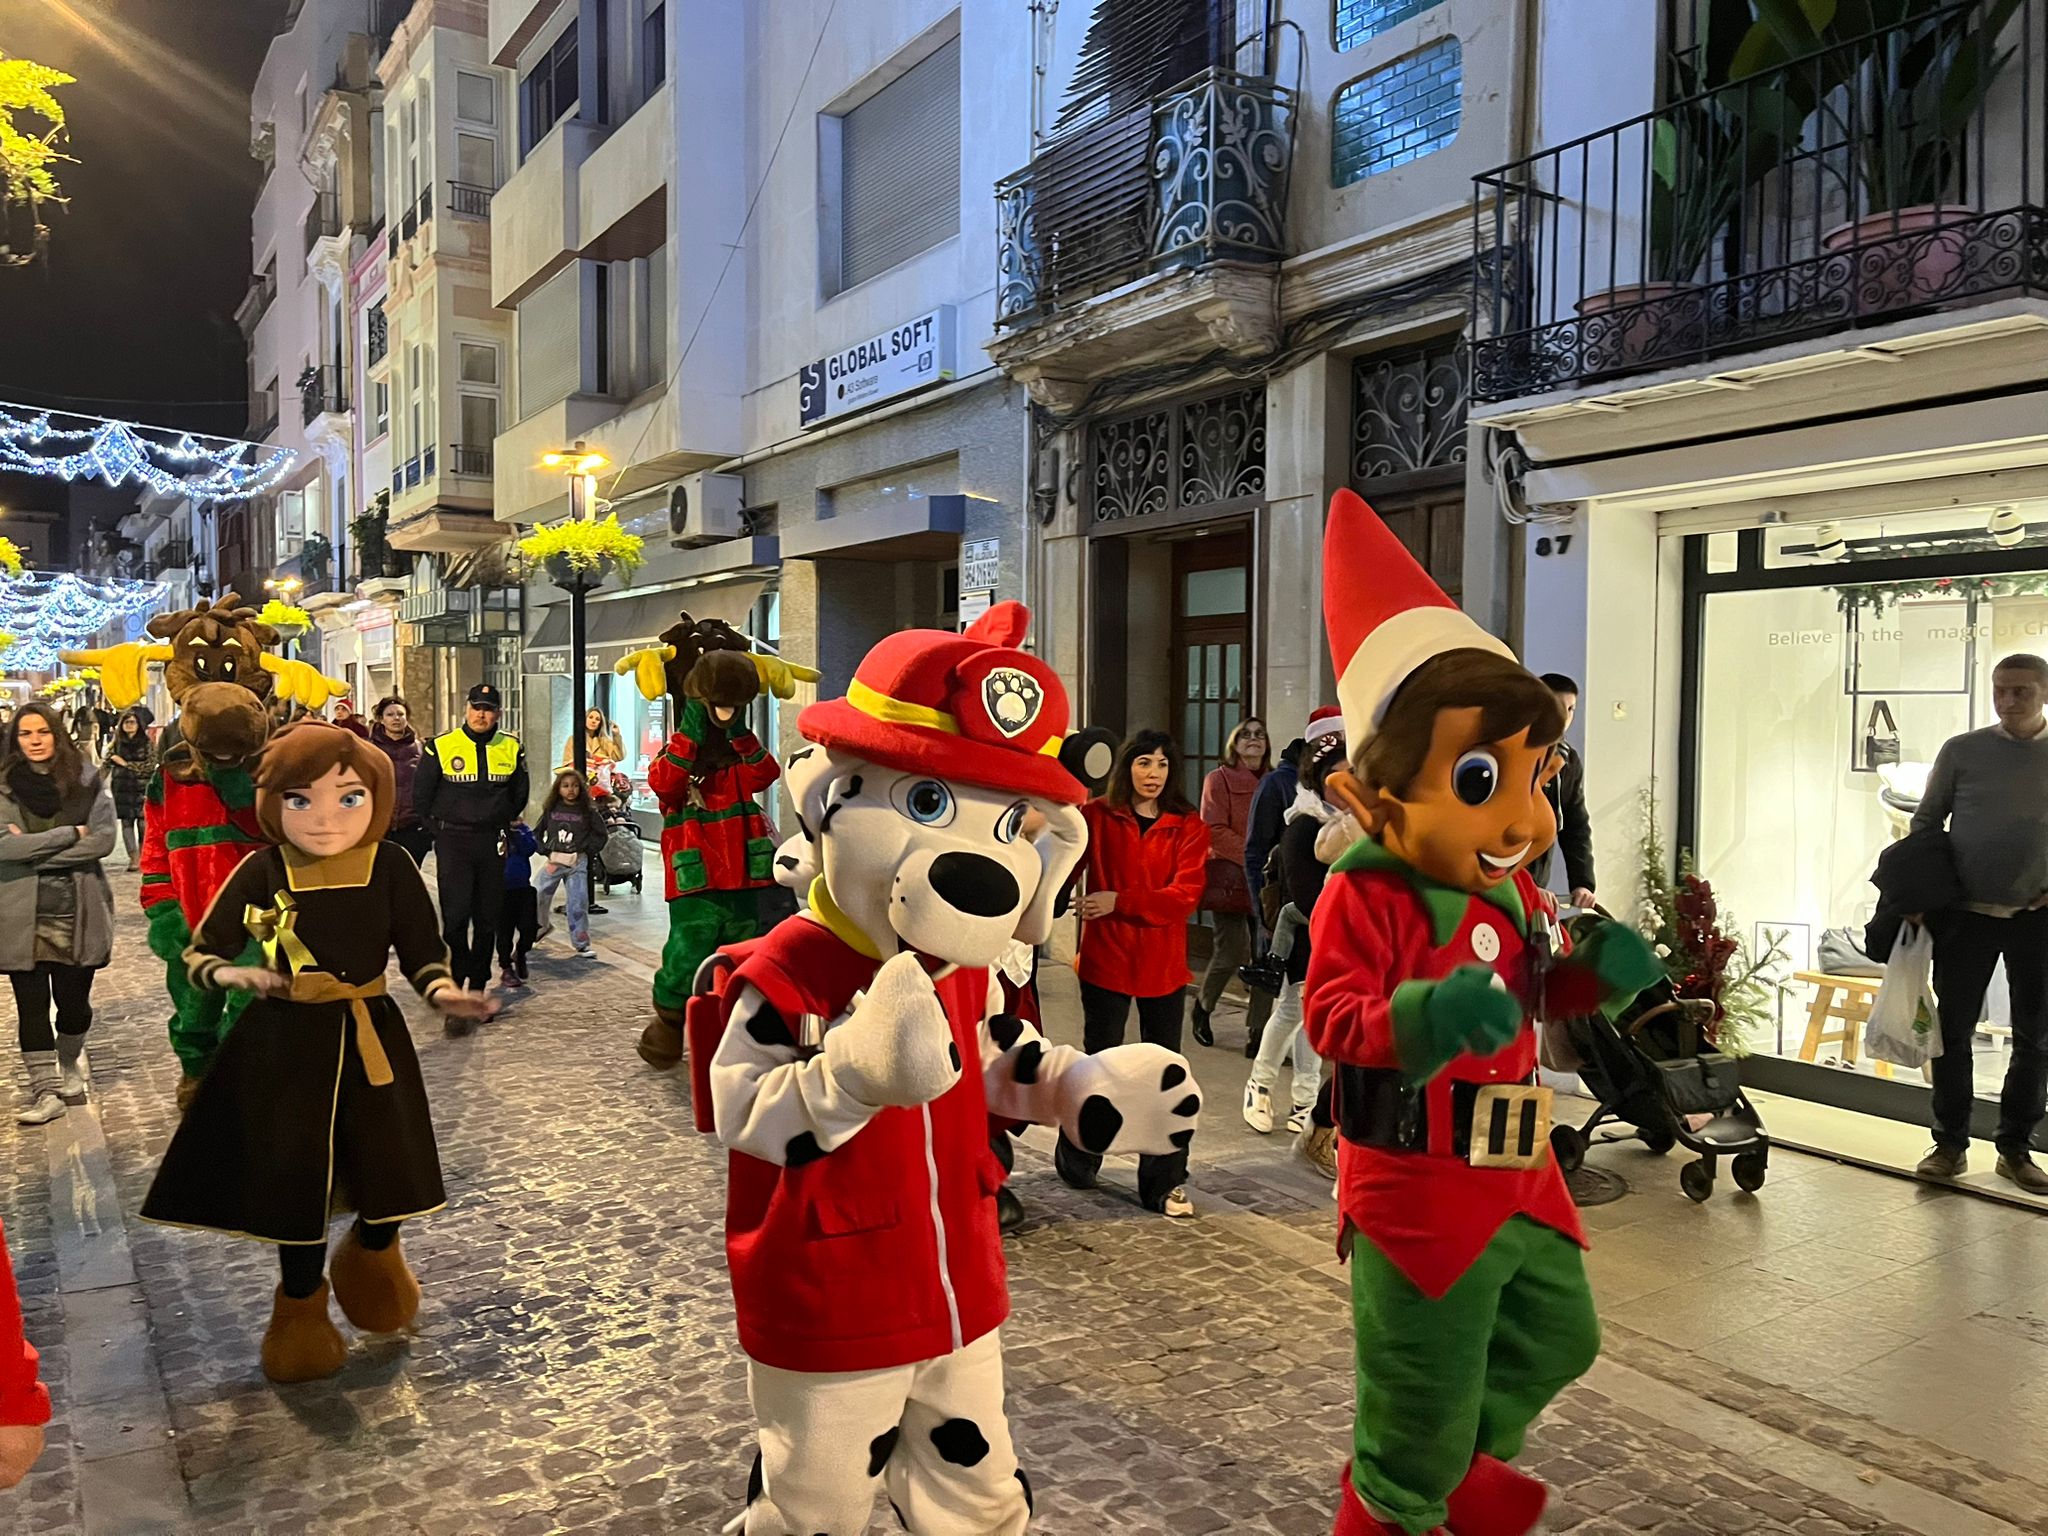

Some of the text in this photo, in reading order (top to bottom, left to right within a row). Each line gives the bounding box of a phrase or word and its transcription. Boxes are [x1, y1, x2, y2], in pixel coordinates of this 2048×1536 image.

[829, 316, 933, 380] GLOBAL SOFT
[1535, 534, 1572, 556] 87
[1768, 631, 1832, 645] Believe
[1872, 627, 1903, 642] the
[1927, 622, 1989, 642] magic
